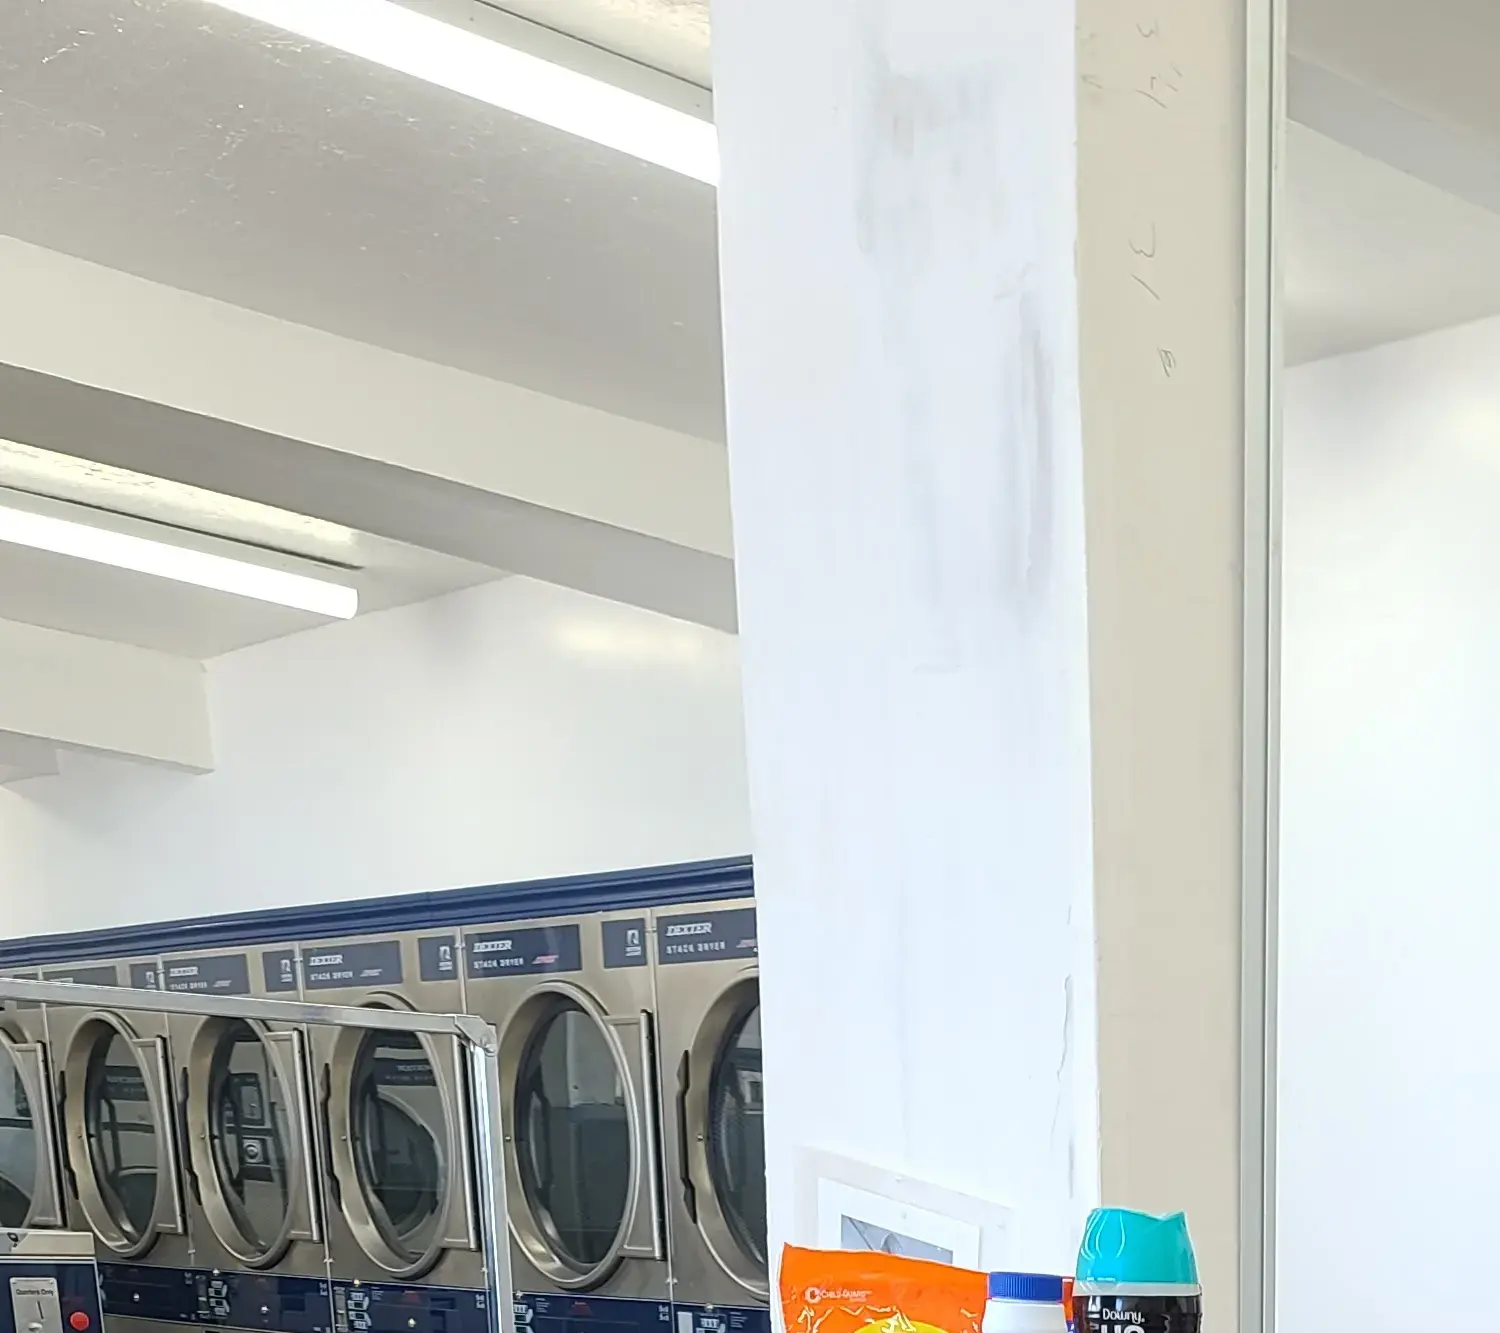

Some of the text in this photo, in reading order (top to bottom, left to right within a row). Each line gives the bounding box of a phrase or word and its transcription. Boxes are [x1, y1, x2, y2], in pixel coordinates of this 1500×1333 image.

[665, 922, 712, 936] DEXTER
[41, 1288, 54, 1296] Only
[1103, 1308, 1142, 1325] Downy
